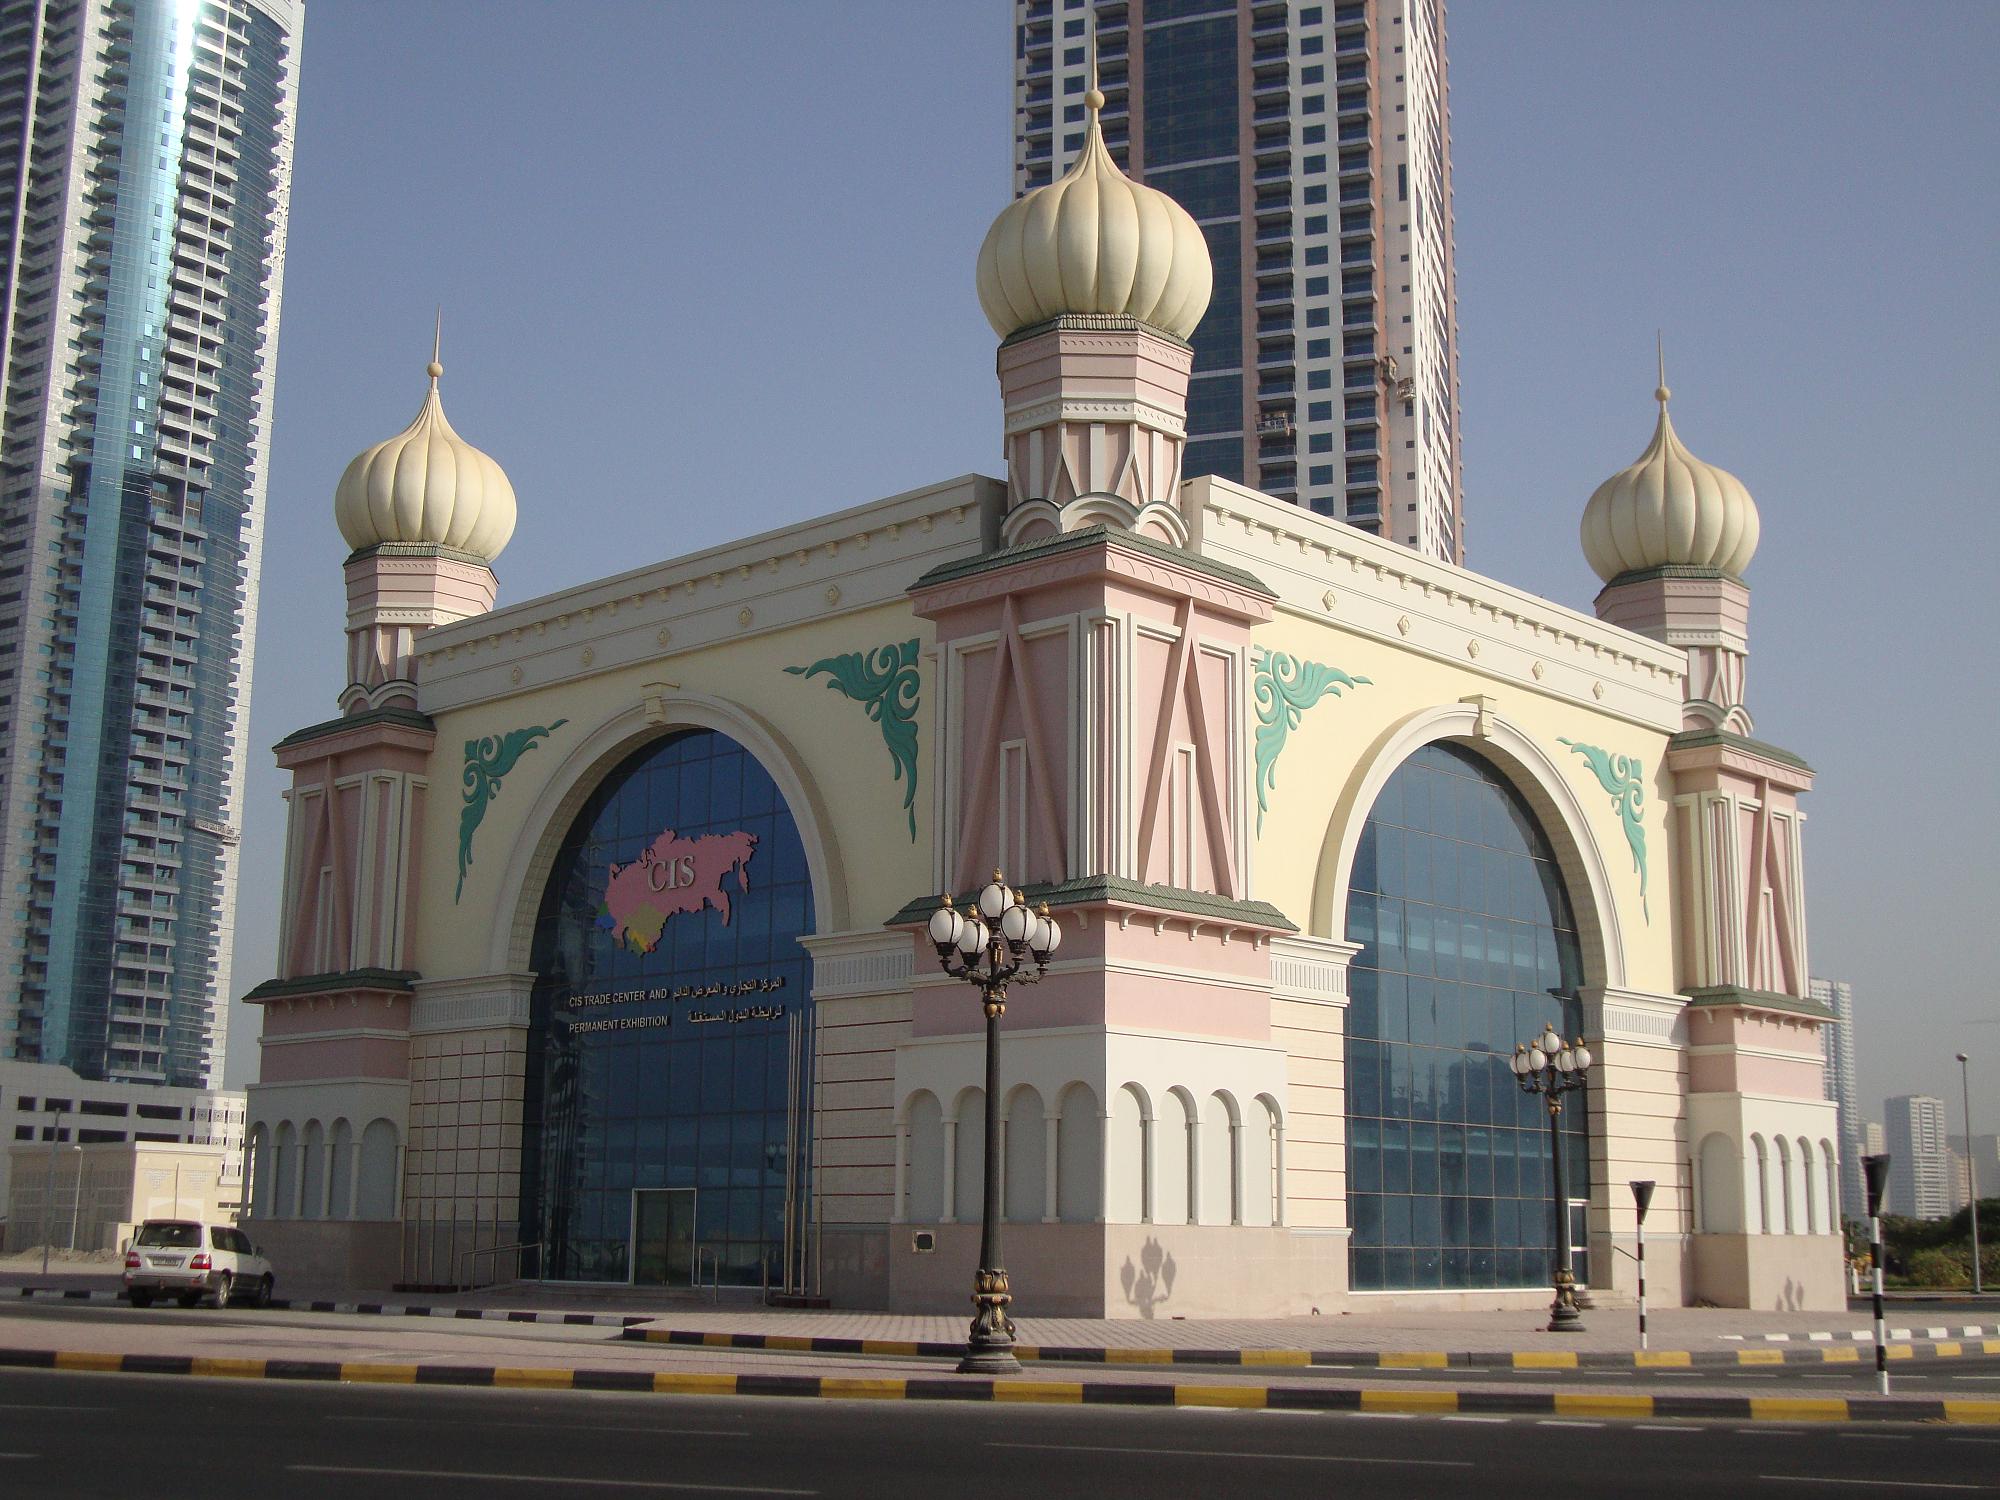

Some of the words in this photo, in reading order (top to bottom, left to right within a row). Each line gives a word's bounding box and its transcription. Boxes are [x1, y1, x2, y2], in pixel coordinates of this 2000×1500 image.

[647, 855, 695, 892] CIS
[691, 981, 721, 998] المعرض
[760, 976, 783, 992] المركز
[569, 996, 583, 1007] CIS
[584, 993, 611, 1006] TRADE
[612, 990, 645, 1003] CENTER
[649, 988, 668, 1000] AND
[729, 1007, 749, 1023] الدول
[569, 1019, 619, 1033] PERMANENT
[620, 1015, 668, 1029] EXHIBITION
